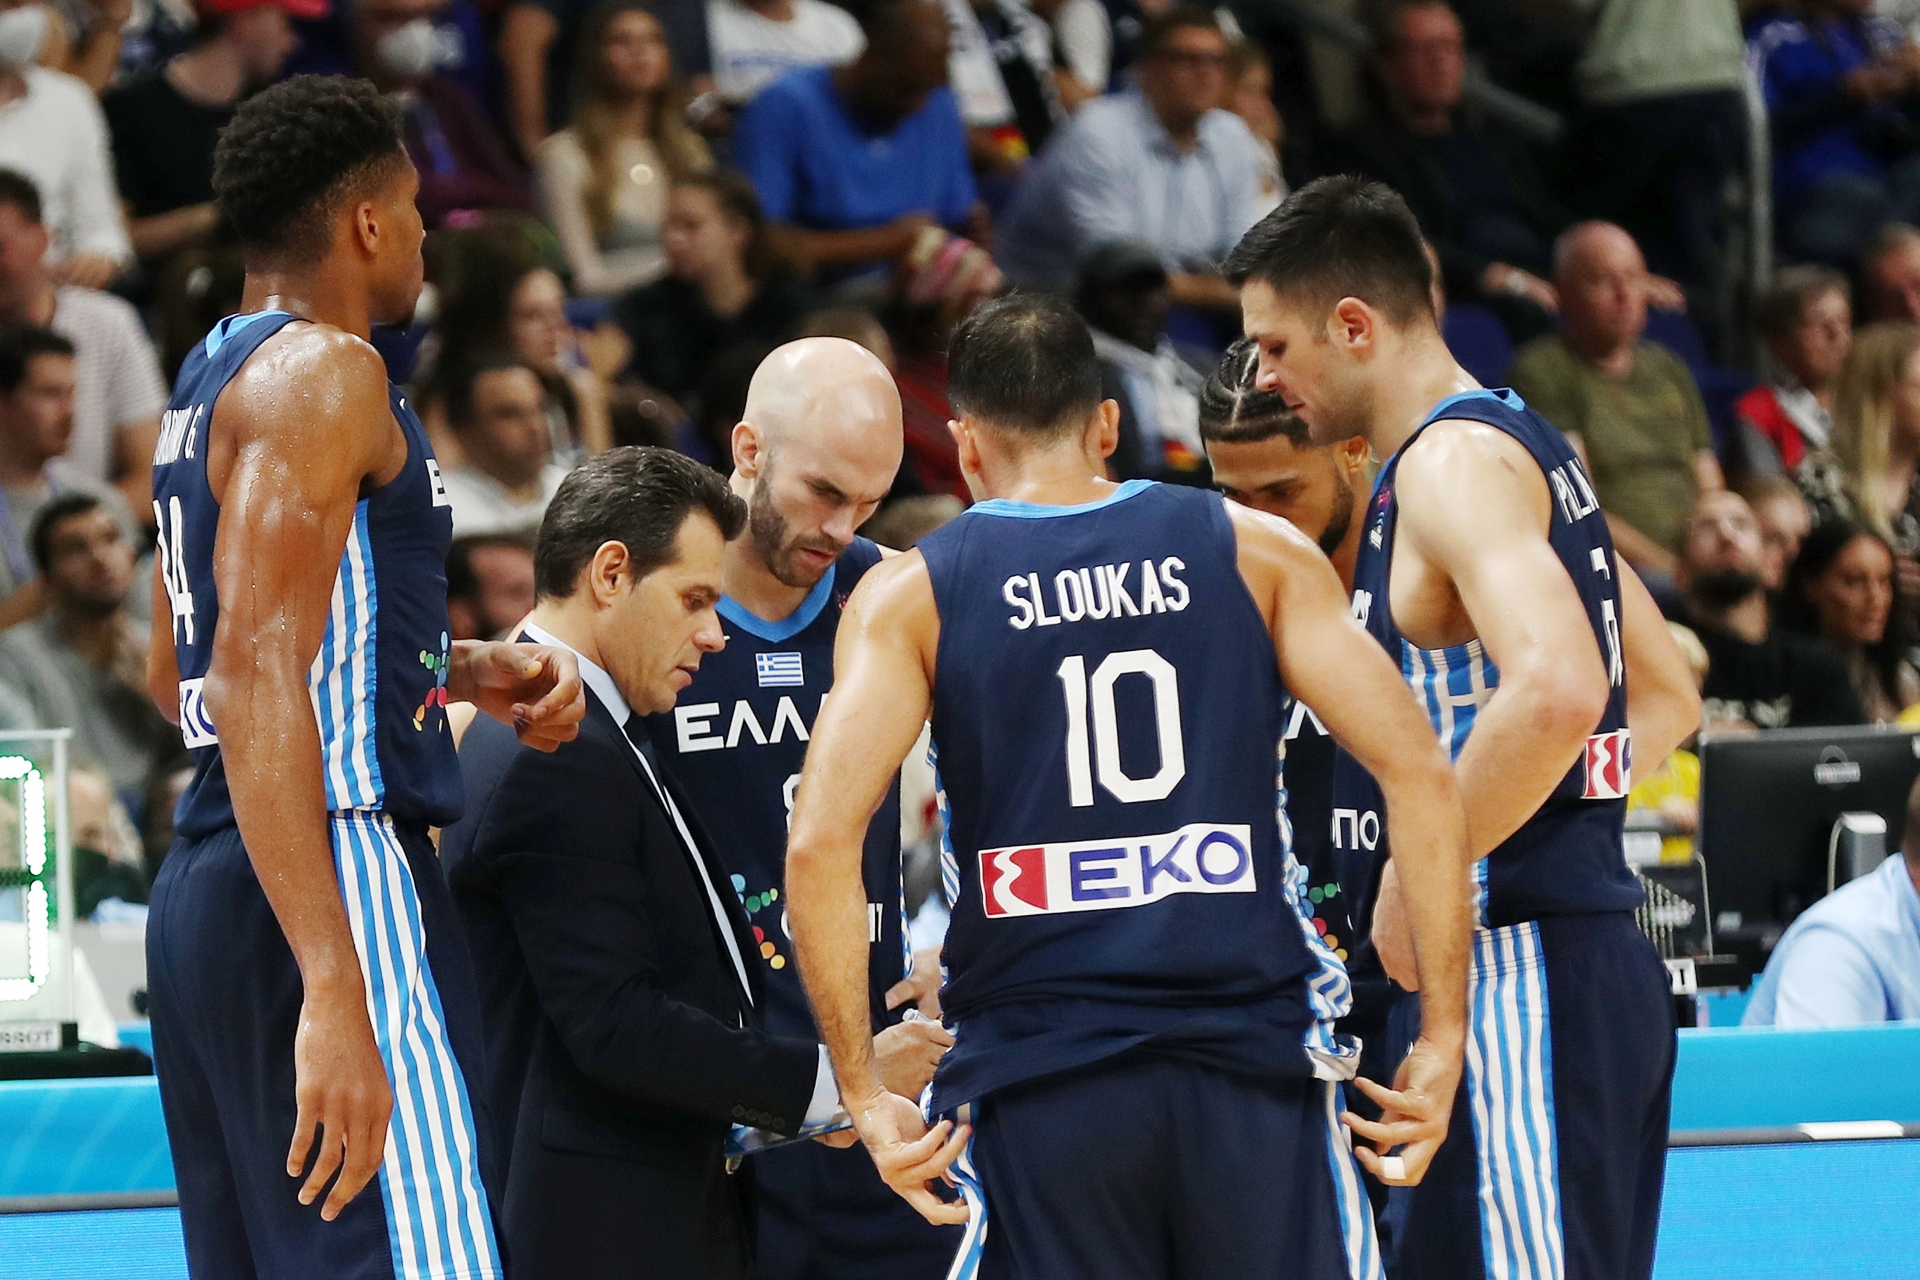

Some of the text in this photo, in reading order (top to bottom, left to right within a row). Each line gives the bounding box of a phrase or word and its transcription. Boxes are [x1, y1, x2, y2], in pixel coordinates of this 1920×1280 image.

[1002, 556, 1190, 630] SLOUKAS
[674, 693, 830, 753] ΕΛΛ
[1057, 648, 1186, 808] 10
[1068, 830, 1250, 901] EKO
